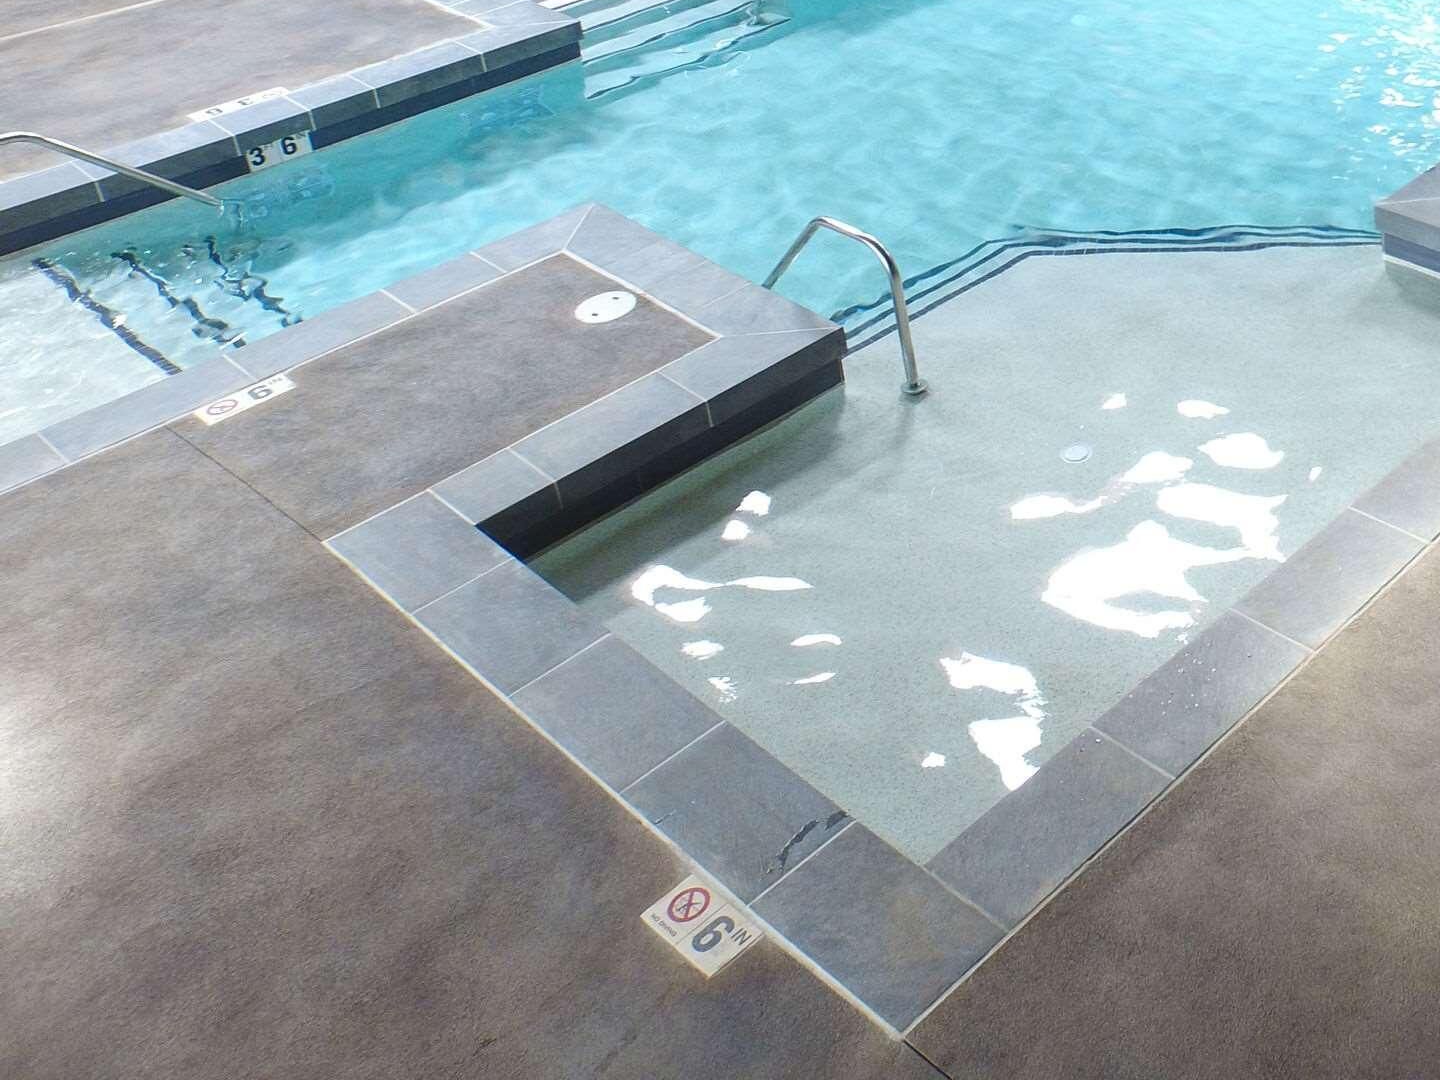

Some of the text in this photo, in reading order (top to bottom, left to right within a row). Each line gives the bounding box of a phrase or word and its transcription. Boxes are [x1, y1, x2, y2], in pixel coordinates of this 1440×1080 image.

[249, 135, 298, 167] 3 6
[691, 915, 753, 953] 6 IN
